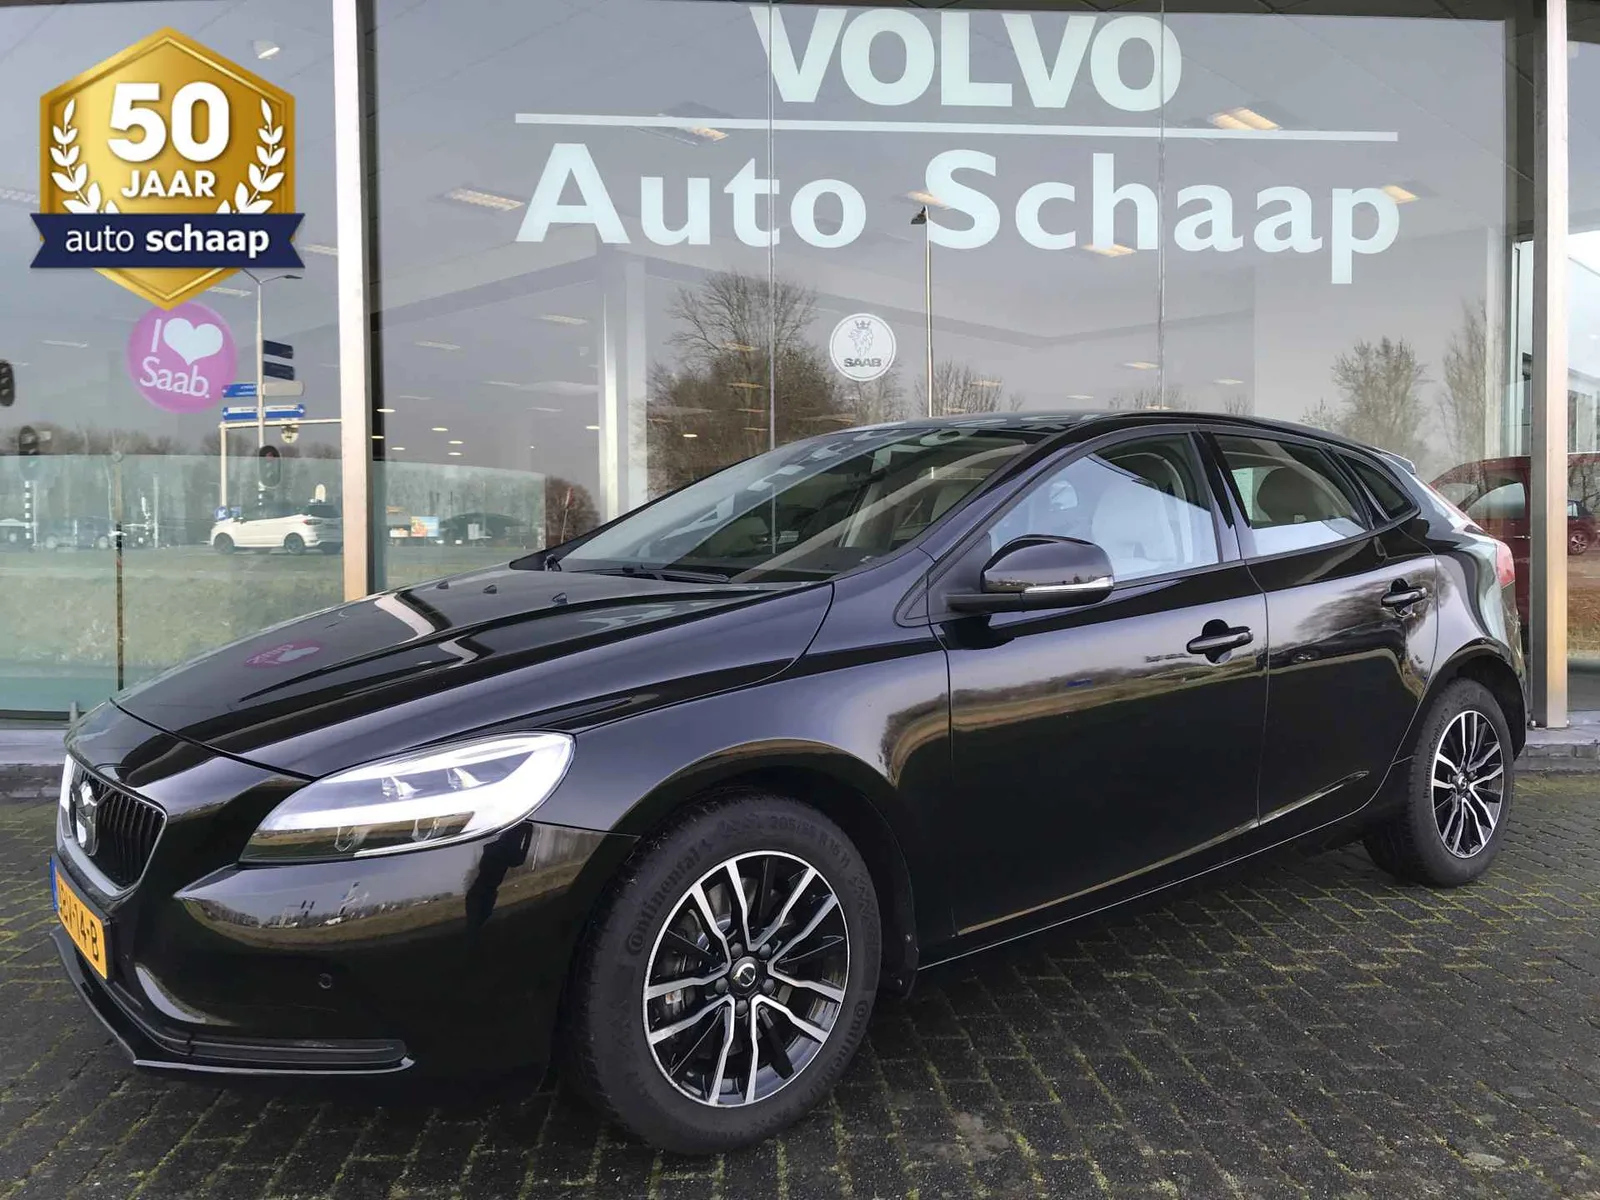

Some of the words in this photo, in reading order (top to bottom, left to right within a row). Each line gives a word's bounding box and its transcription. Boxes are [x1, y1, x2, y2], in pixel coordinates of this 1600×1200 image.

[750, 5, 1183, 112] VOLVO
[516, 143, 867, 249] Auto
[924, 148, 1401, 284] Schaap
[150, 318, 163, 353] I
[843, 357, 882, 368] SAAB
